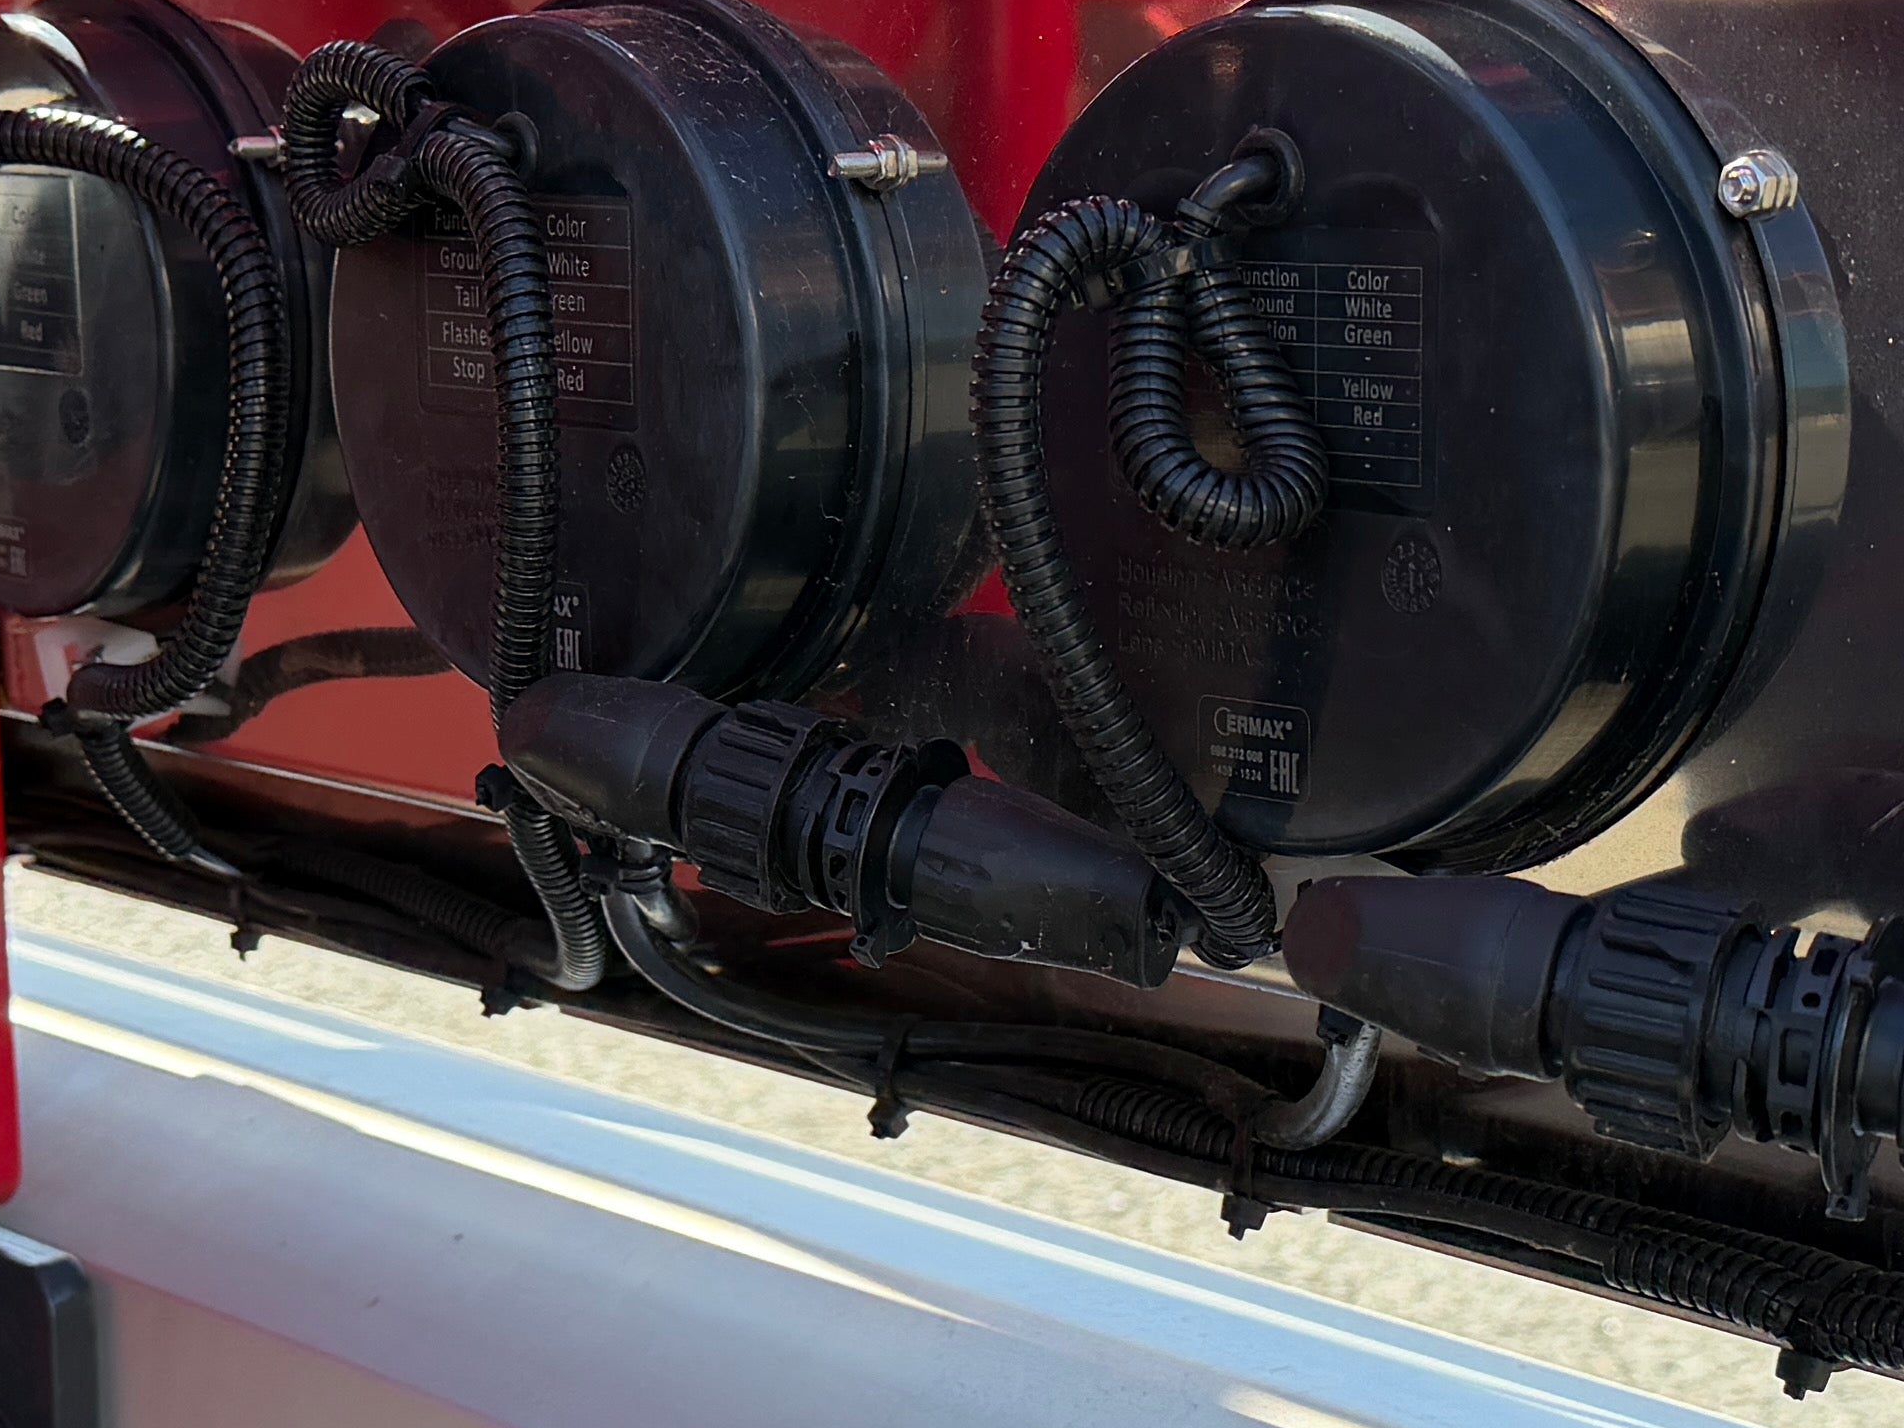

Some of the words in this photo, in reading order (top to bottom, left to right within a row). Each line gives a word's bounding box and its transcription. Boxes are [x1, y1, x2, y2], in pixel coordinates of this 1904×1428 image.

[434, 208, 469, 232] Func
[546, 213, 587, 243] Color
[546, 251, 591, 278] White
[1346, 269, 1390, 293] Color
[453, 285, 480, 309] Tail
[551, 292, 586, 313] reen
[1343, 296, 1394, 320] White
[20, 319, 44, 342] Red
[441, 321, 489, 347] Flashe
[548, 329, 594, 355] ellow
[1343, 323, 1393, 347] Green
[452, 355, 486, 384] Stop
[556, 367, 585, 393] Red
[1342, 377, 1394, 401] Yellow
[1352, 405, 1384, 427] Red
